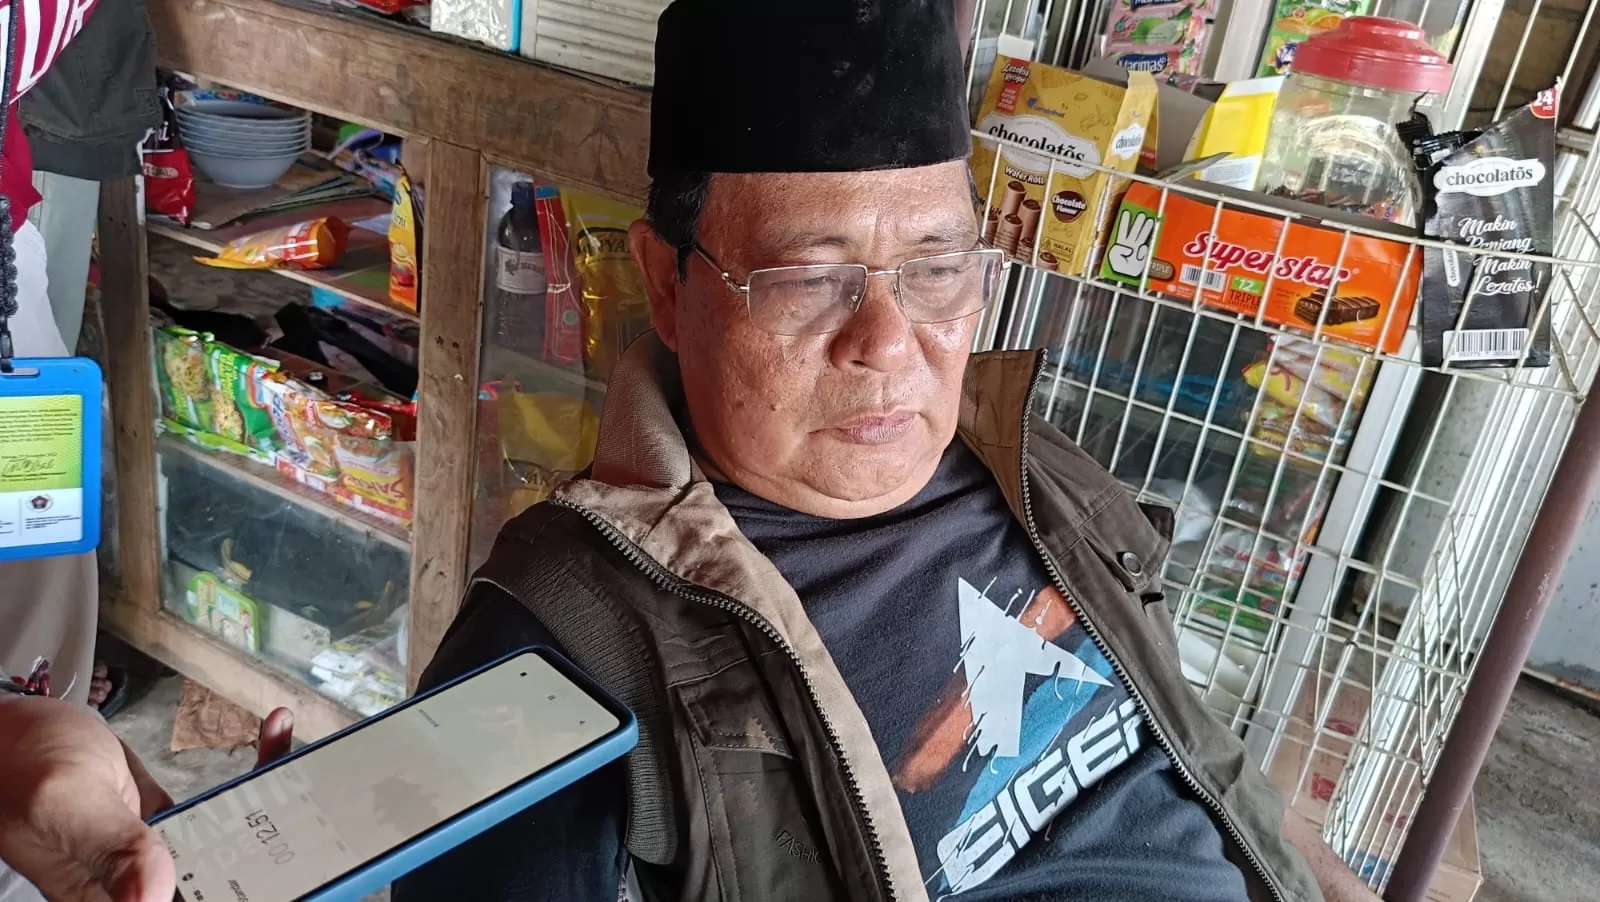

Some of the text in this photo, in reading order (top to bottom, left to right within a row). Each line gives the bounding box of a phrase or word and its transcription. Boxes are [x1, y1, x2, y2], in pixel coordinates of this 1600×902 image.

[1051, 194, 1087, 212] Chocolate
[1457, 214, 1519, 238] Makin
[1184, 231, 1350, 288] Superstar
[1473, 255, 1532, 275] Makin
[1237, 278, 1254, 290] 12
